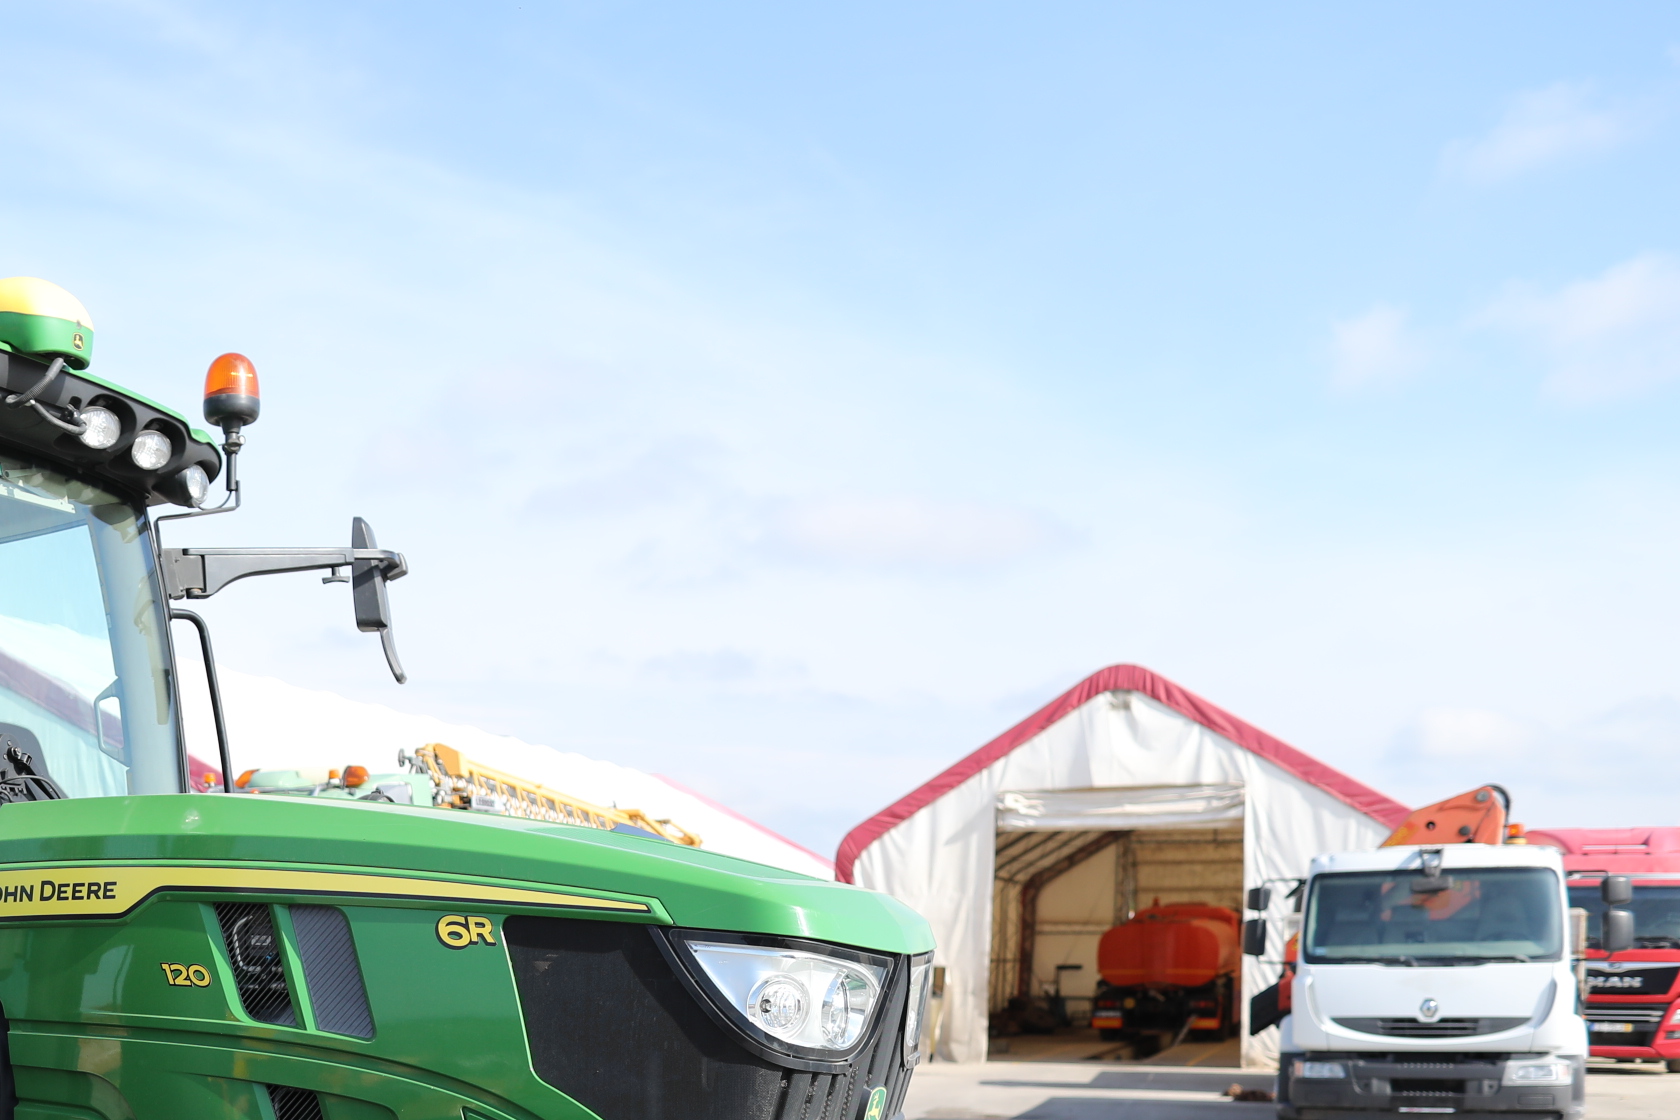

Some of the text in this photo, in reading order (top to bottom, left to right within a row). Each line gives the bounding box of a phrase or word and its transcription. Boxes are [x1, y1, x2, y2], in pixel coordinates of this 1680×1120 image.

[39, 880, 118, 902] DEERE
[435, 914, 498, 950] 6R
[160, 961, 213, 989] 120
[1586, 976, 1644, 988] MAN
